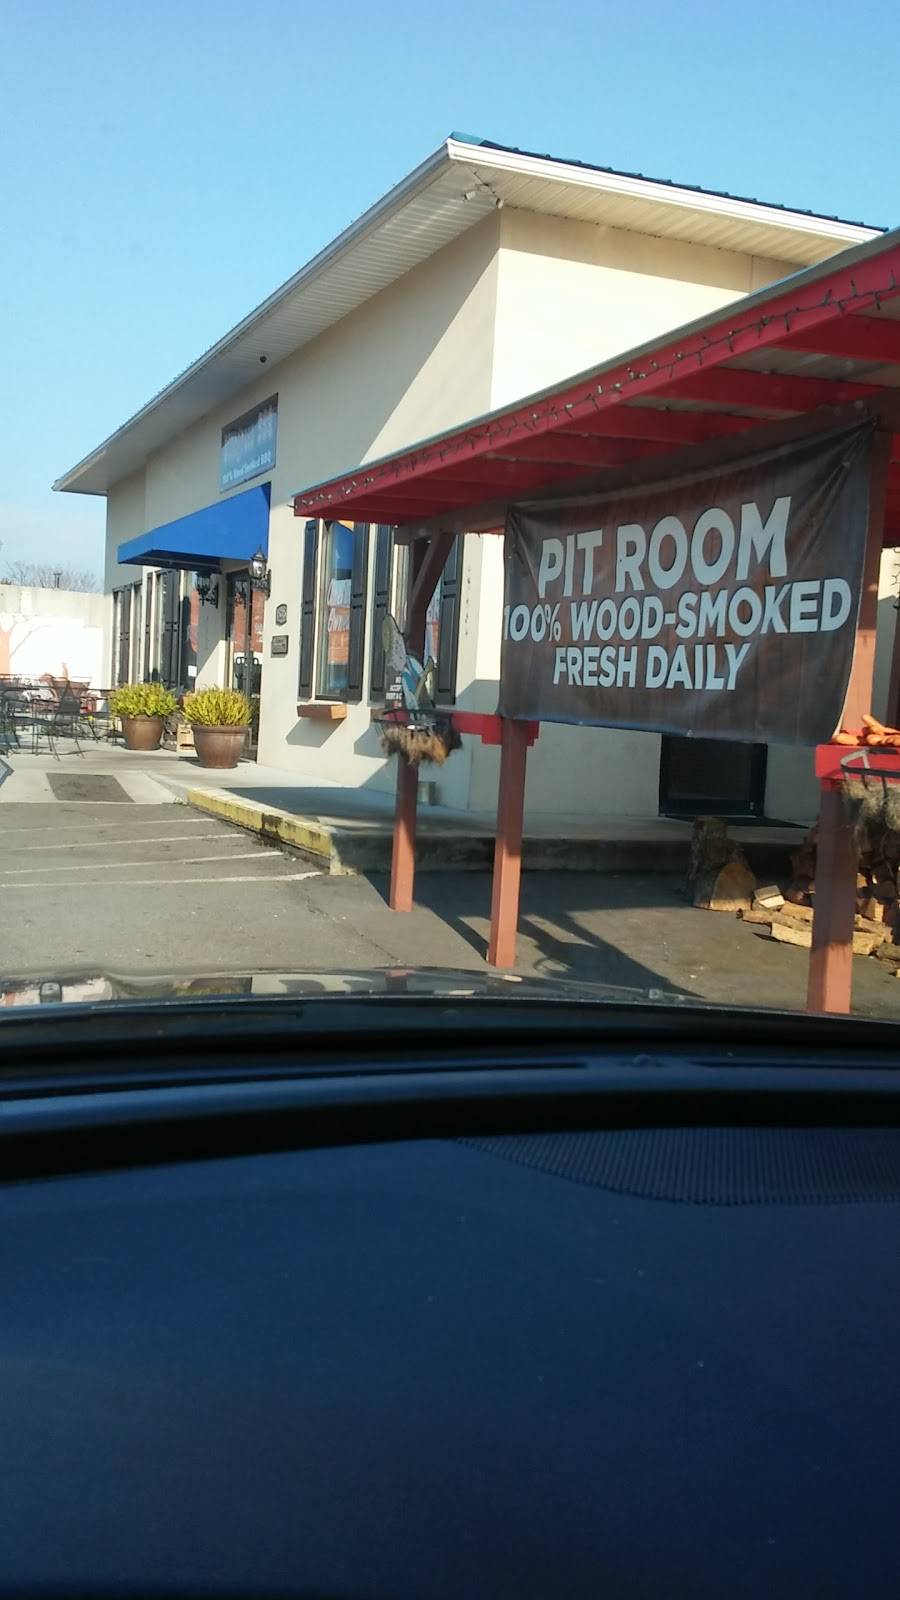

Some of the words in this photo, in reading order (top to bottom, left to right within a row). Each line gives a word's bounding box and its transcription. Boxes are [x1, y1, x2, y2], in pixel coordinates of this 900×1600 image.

[538, 529, 603, 599] PIT
[615, 496, 792, 593] ROOM
[504, 603, 562, 642] 100%
[570, 577, 852, 642] WOOD-SMOKED
[553, 645, 638, 688] FRESH
[646, 642, 751, 691] DAILY
